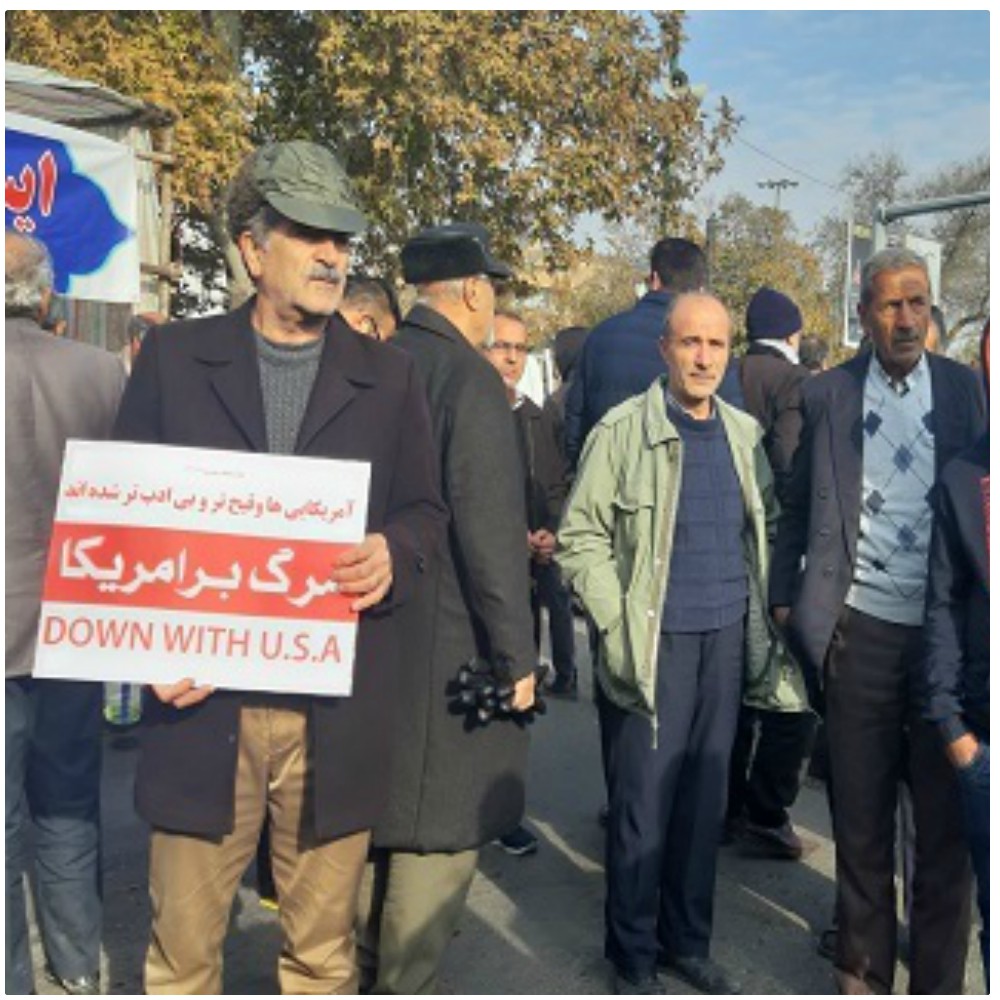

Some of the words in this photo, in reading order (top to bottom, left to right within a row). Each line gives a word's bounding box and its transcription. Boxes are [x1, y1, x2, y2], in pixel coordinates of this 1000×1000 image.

[249, 547, 340, 608] مرگ
[43, 615, 153, 651] DOWN
[163, 622, 250, 658] WITH
[259, 630, 342, 663] U.S.A
